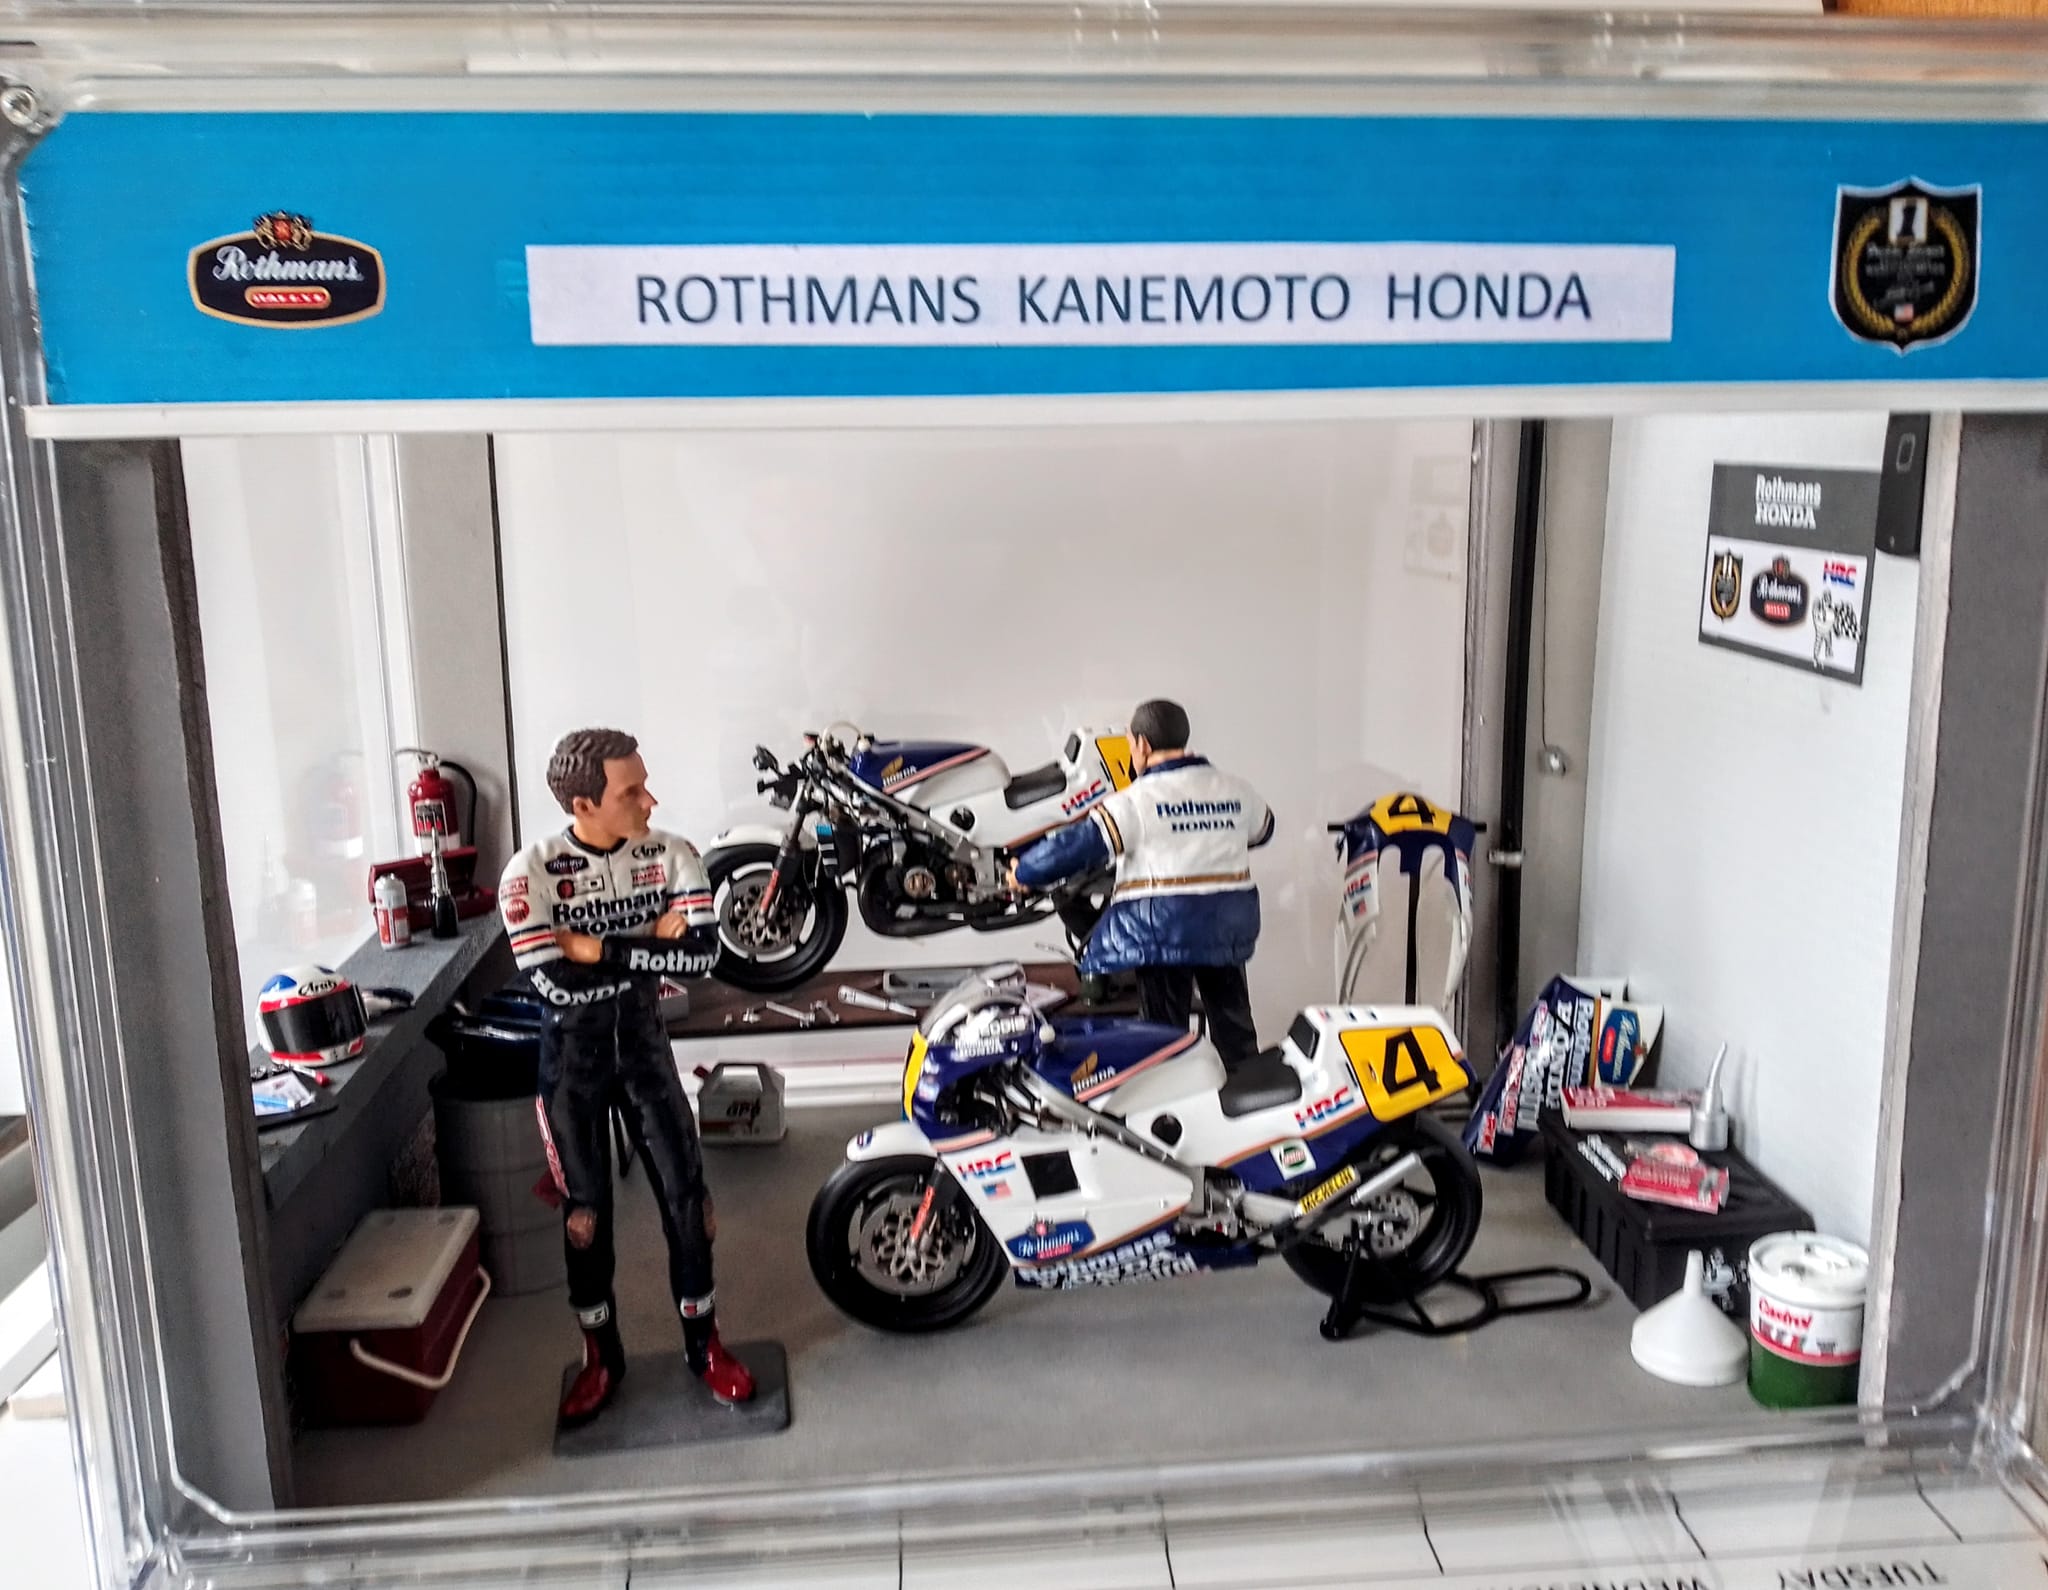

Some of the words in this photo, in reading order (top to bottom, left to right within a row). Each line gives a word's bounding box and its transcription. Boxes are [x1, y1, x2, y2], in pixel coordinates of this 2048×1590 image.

[212, 245, 365, 281] Rothmans
[636, 275, 981, 324] ROTHMANS
[1018, 274, 1351, 324] KANEMOTO
[1387, 271, 1593, 322] HONDA
[1755, 473, 1822, 508] Rothmans
[1754, 501, 1817, 530] HONDA
[1060, 779, 1107, 816] HRC
[1155, 798, 1242, 819] Rothmans
[1170, 818, 1236, 834] HONDA
[1382, 1027, 1442, 1096] 4
[1570, 997, 1595, 1091] Rothm
[1294, 1085, 1356, 1131] HRC
[957, 1149, 1017, 1182] HRC
